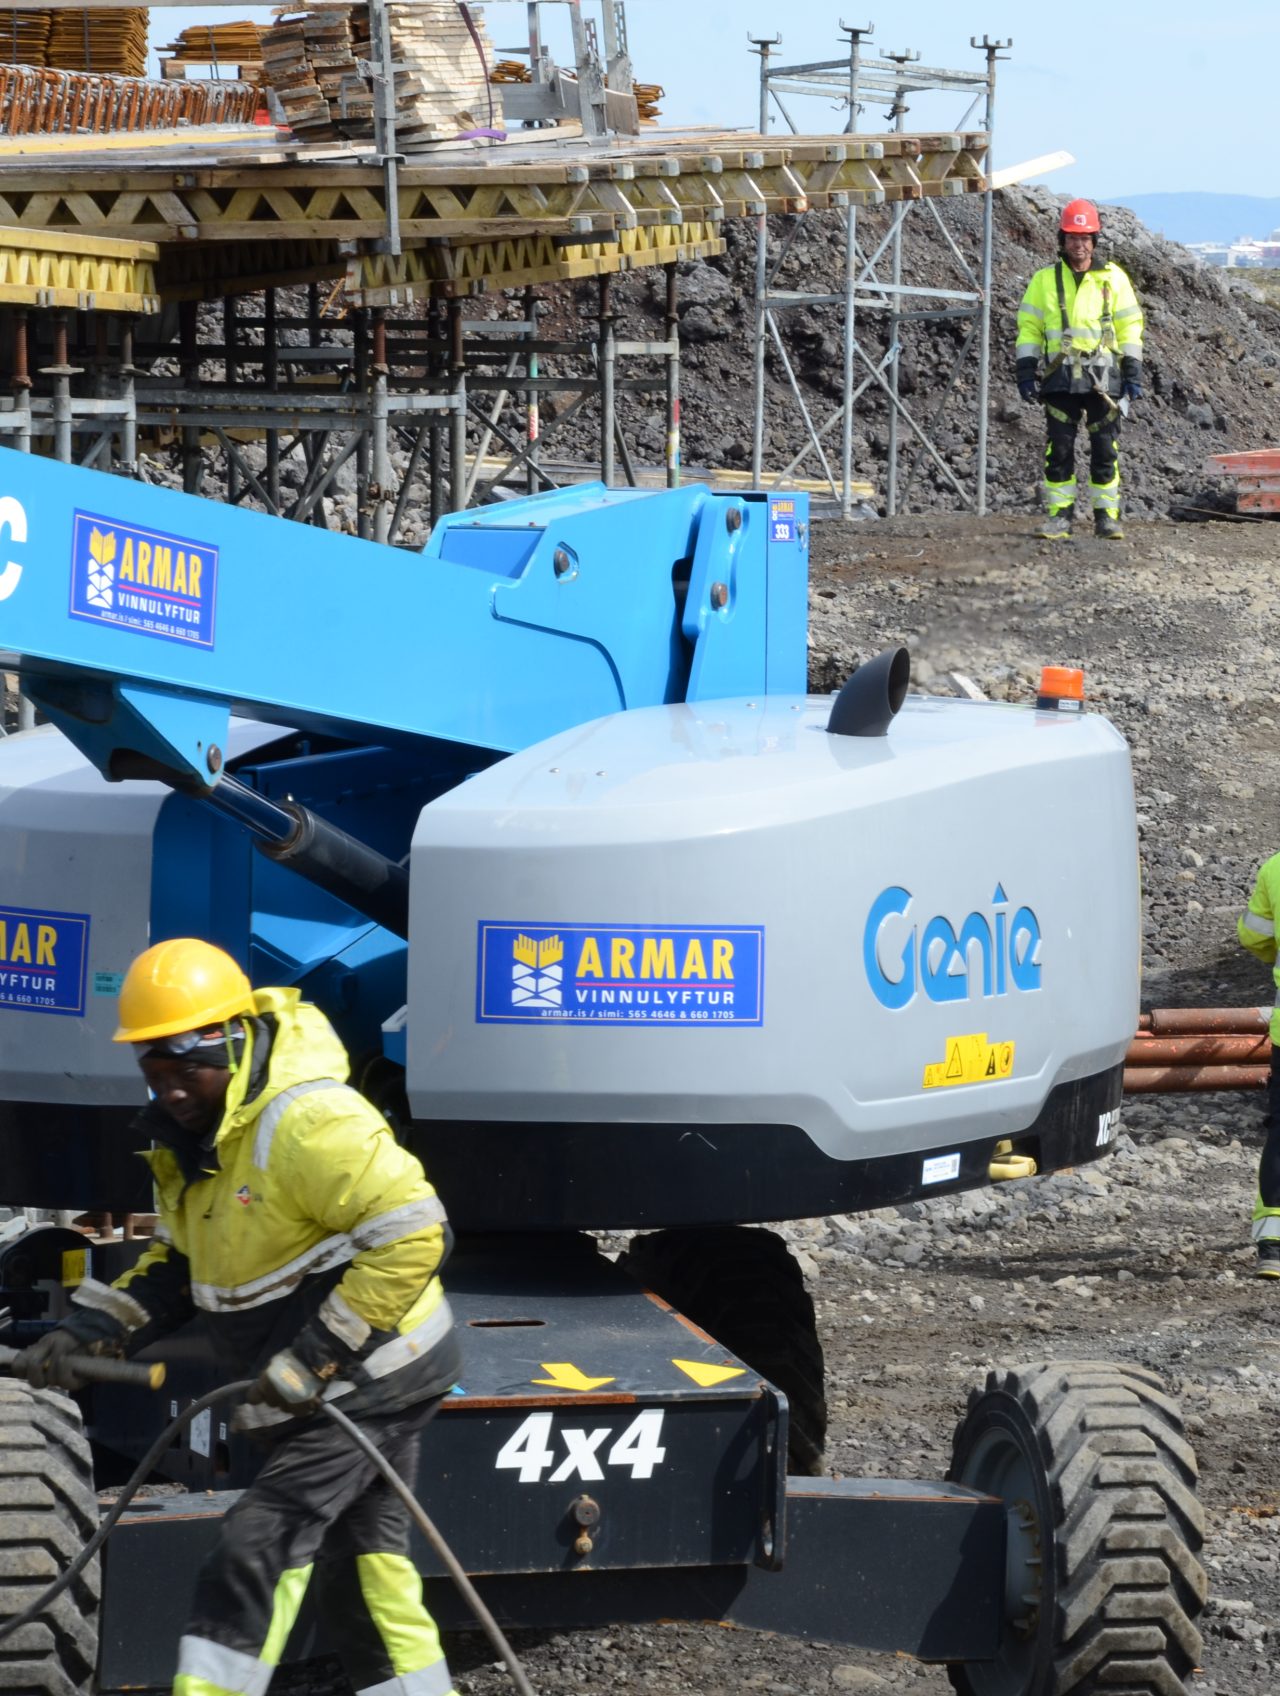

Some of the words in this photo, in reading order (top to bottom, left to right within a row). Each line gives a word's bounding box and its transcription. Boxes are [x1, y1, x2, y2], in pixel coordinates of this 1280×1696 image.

[775, 524, 789, 539] 333
[119, 538, 202, 598] ARMAR
[118, 592, 200, 625] VINNULYFTUR
[0, 920, 57, 966] AR
[575, 937, 735, 980] ARMAR
[863, 881, 1042, 1011] Genie
[35, 996, 56, 1006] 1705
[541, 1008, 587, 1018] armar.is
[628, 1010, 647, 1018] 565
[651, 1010, 676, 1018] 4646
[680, 1010, 686, 1018] &
[690, 1011, 708, 1019] 660
[712, 1011, 735, 1019] 1705
[575, 990, 735, 1005] VINNULYFTUR
[495, 1408, 667, 1483] 4x4
